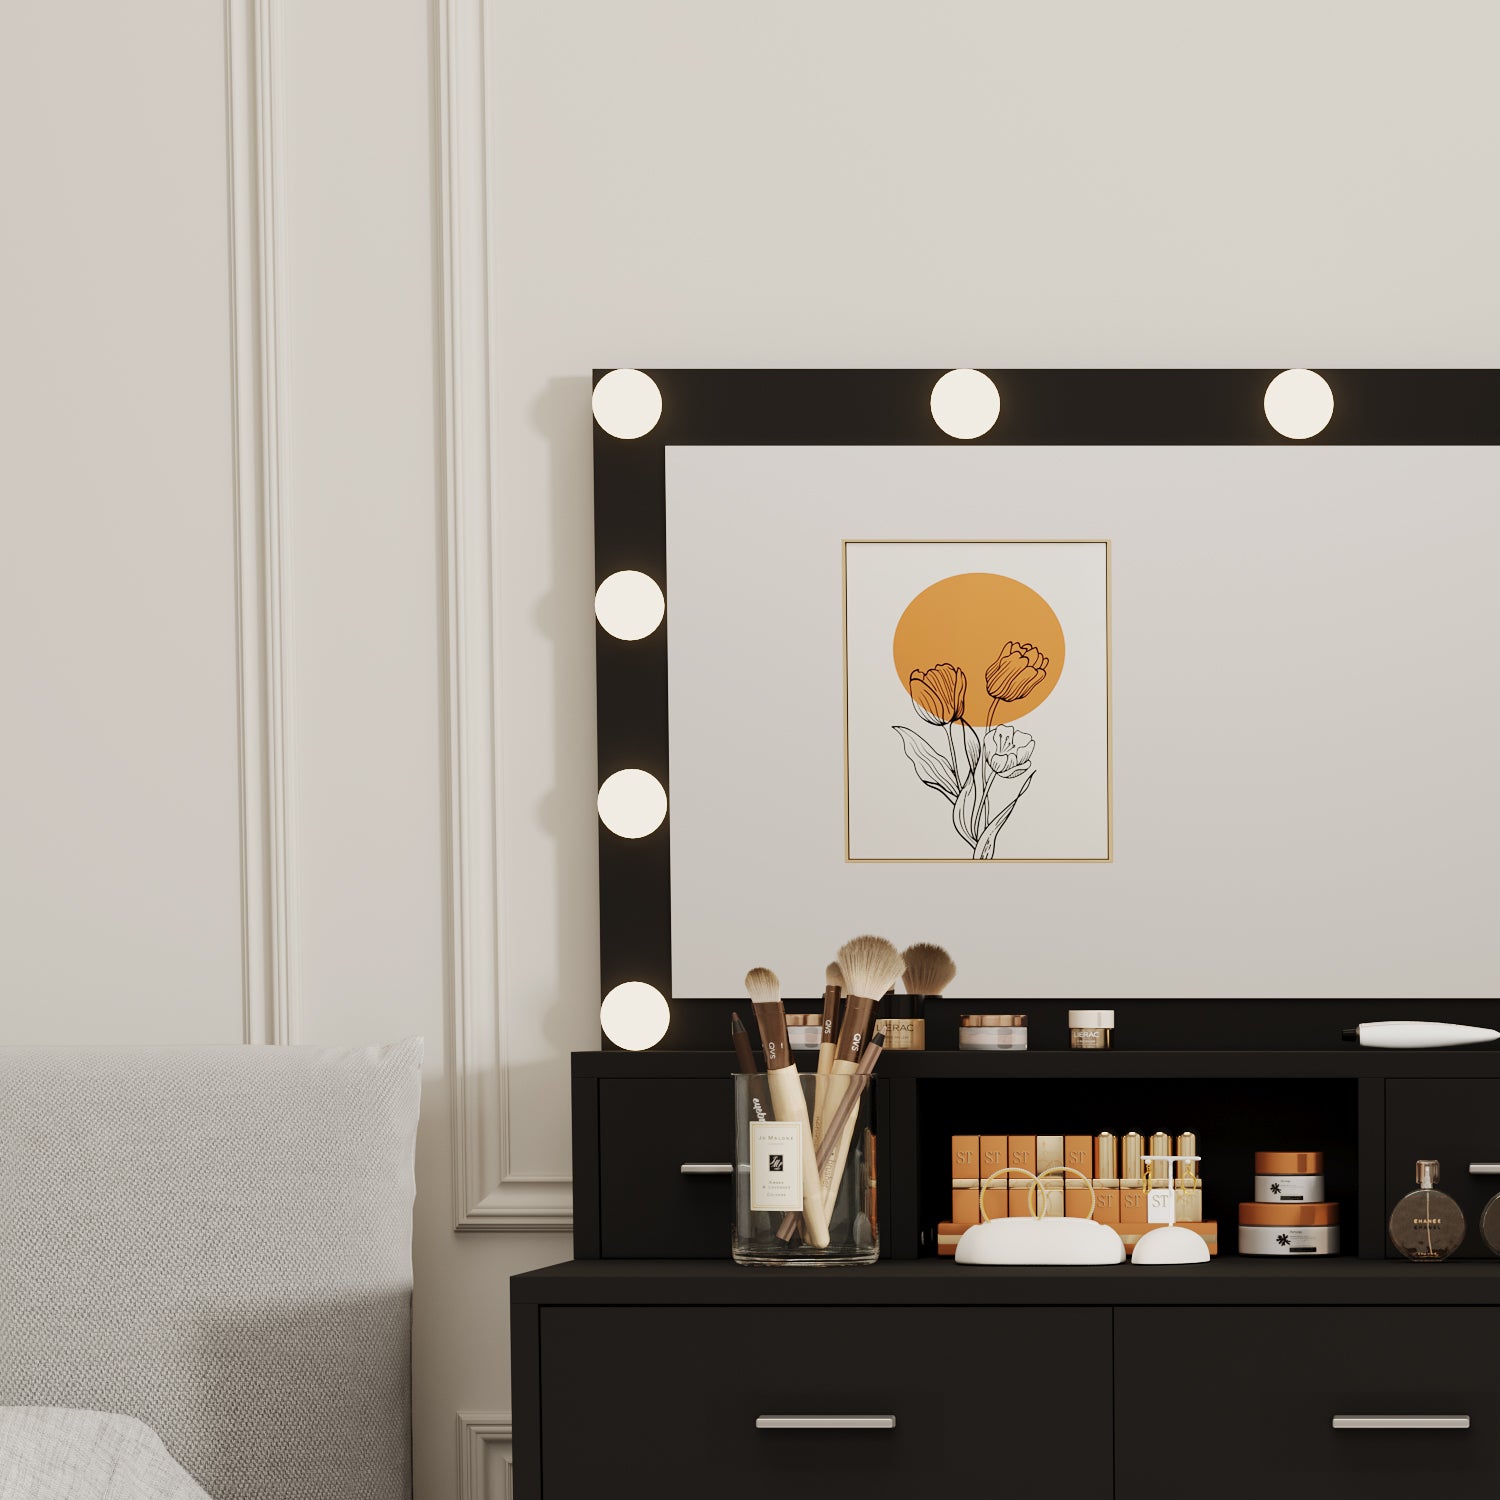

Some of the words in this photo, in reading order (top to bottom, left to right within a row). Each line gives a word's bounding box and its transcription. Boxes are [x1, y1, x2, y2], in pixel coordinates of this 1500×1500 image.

[824, 1019, 832, 1035] QVS
[876, 1024, 914, 1032] LERAC
[851, 1033, 862, 1052] QVS
[768, 1041, 776, 1060] QVS
[955, 1151, 973, 1165] ST
[984, 1151, 1001, 1165] ST
[1012, 1151, 1030, 1165] ST
[1069, 1151, 1086, 1165] ST
[1096, 1194, 1113, 1208] ST
[1124, 1194, 1142, 1208] ST
[1151, 1194, 1169, 1208] ST
